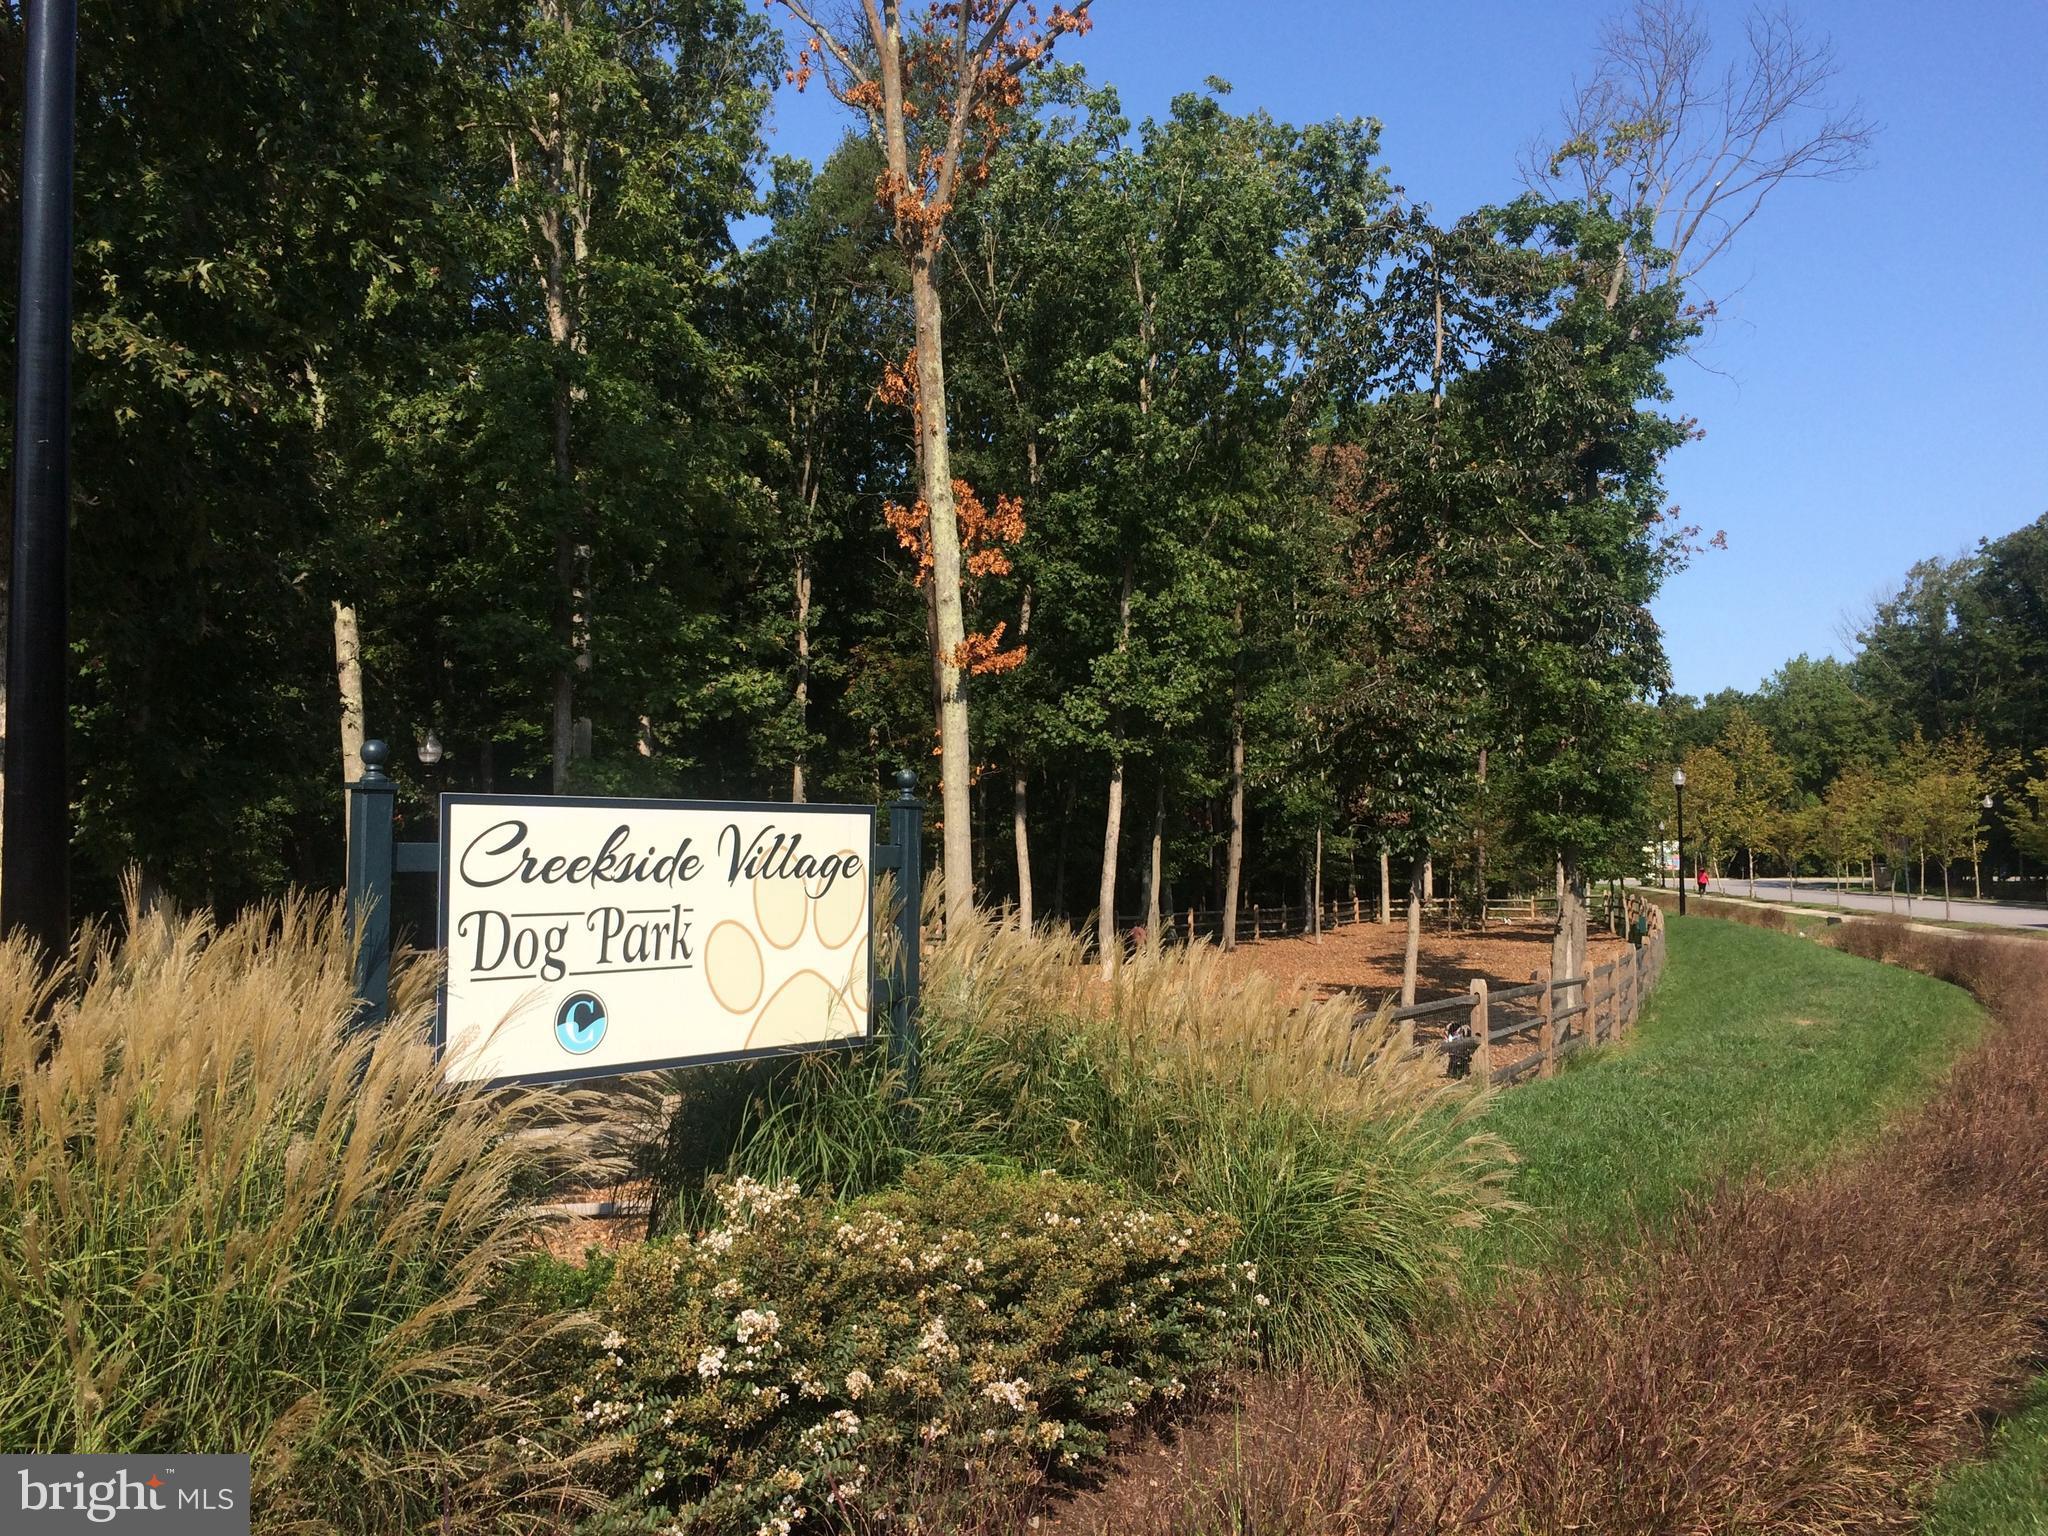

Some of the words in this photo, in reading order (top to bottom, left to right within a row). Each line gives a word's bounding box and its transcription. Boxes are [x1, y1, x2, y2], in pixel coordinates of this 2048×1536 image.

[459, 819, 704, 889] Creekside
[717, 824, 864, 900] Village
[458, 909, 570, 982] Dog
[586, 903, 693, 965] Park
